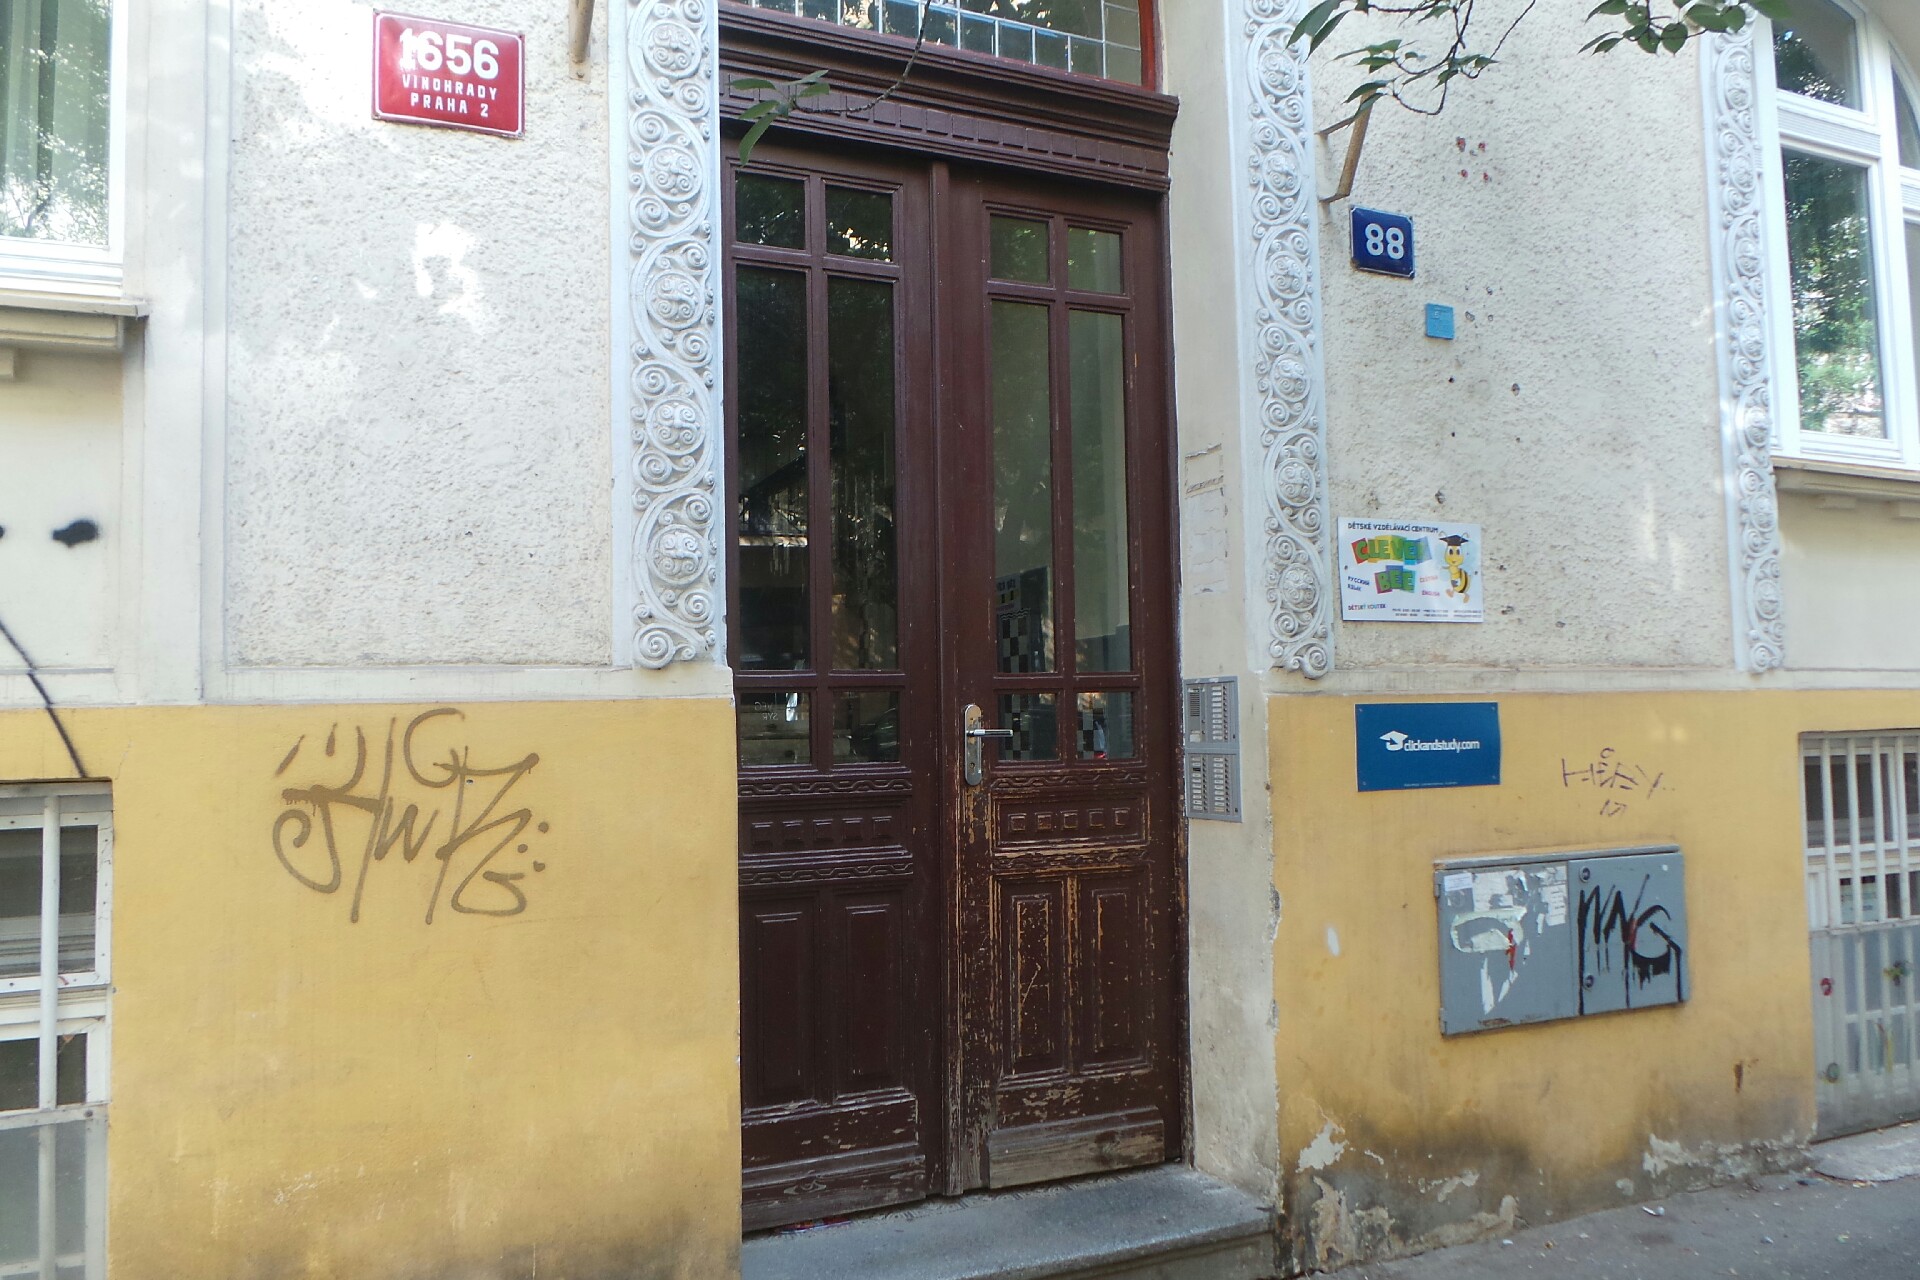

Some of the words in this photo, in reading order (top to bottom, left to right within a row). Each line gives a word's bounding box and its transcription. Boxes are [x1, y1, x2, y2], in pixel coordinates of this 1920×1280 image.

[399, 28, 499, 80] 1656
[402, 74, 498, 101] VINOHRADY
[411, 92, 468, 115] PRAHA
[480, 103, 489, 118] 2
[1364, 222, 1405, 260] 88
[1377, 568, 1415, 592] BEE
[1404, 739, 1480, 753] clickandstudy.com
